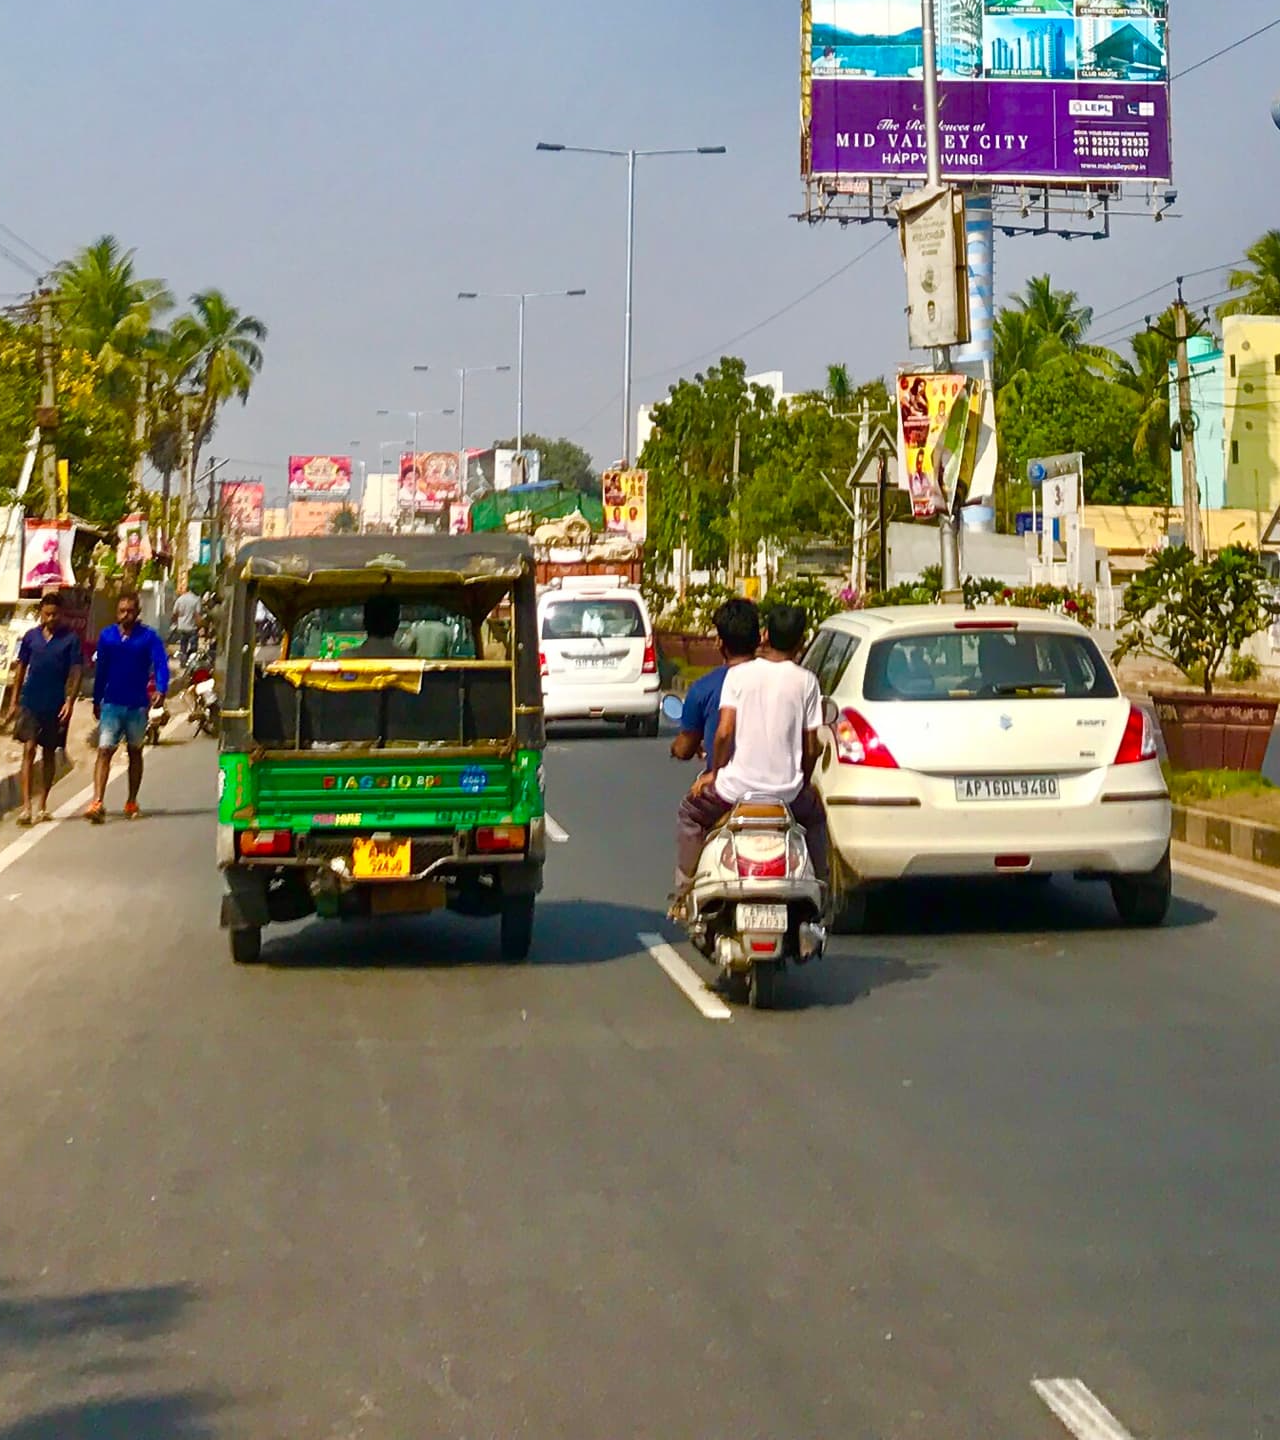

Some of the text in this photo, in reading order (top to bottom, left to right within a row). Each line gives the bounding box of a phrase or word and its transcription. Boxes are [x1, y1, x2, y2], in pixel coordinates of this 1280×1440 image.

[876, 119, 985, 132] The Reences at
[836, 133, 1029, 149] MID VALEY CITY
[1073, 137, 1089, 145] +91
[1073, 147, 1089, 156] +91
[882, 152, 983, 166] HAPPY IVING!
